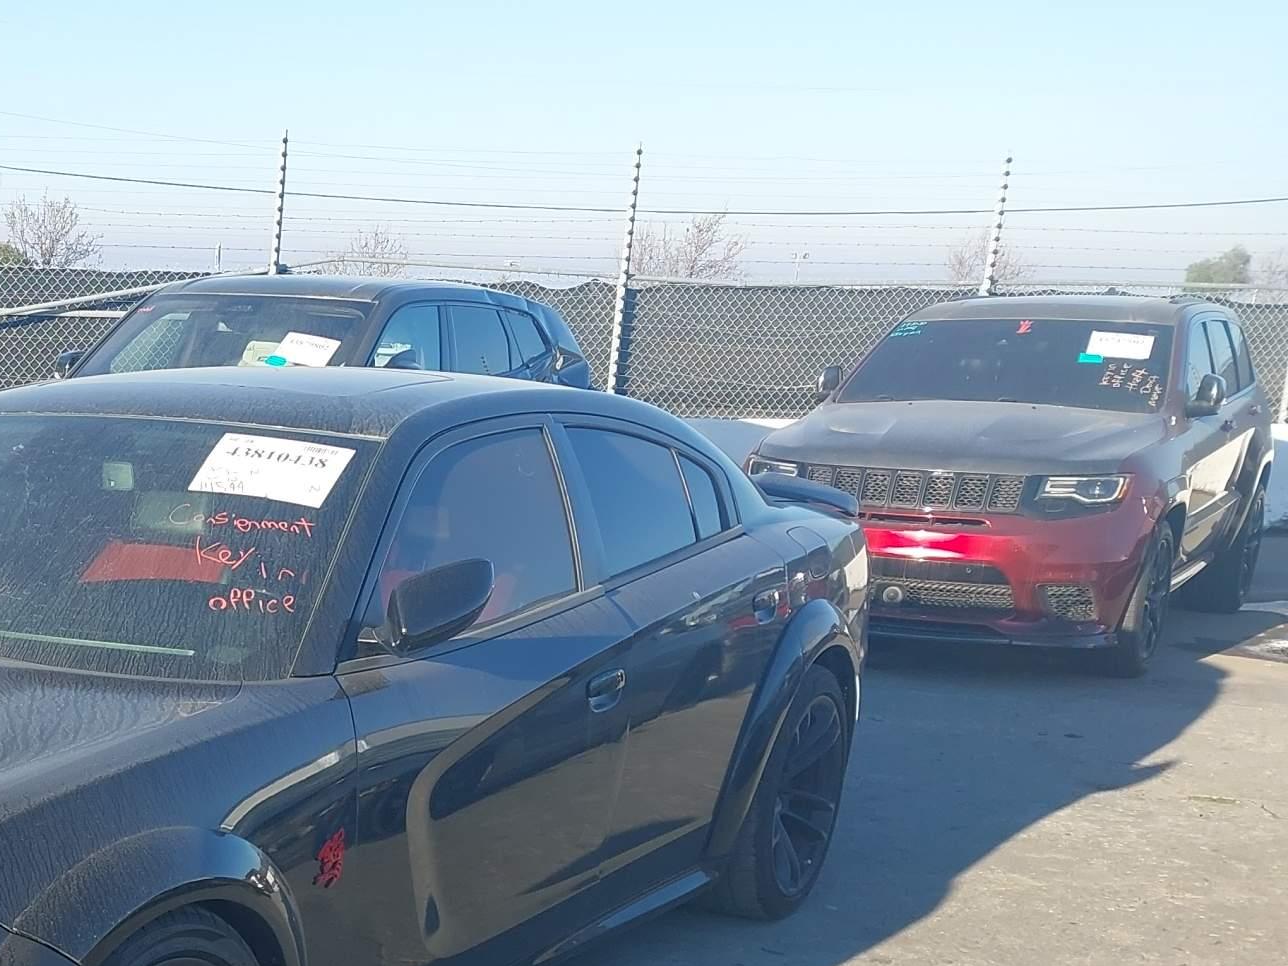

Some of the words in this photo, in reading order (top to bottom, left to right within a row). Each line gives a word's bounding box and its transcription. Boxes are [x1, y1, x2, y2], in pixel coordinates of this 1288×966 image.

[225, 446, 329, 469] 43810438
[196, 535, 255, 570] Key
[208, 588, 294, 613] office
